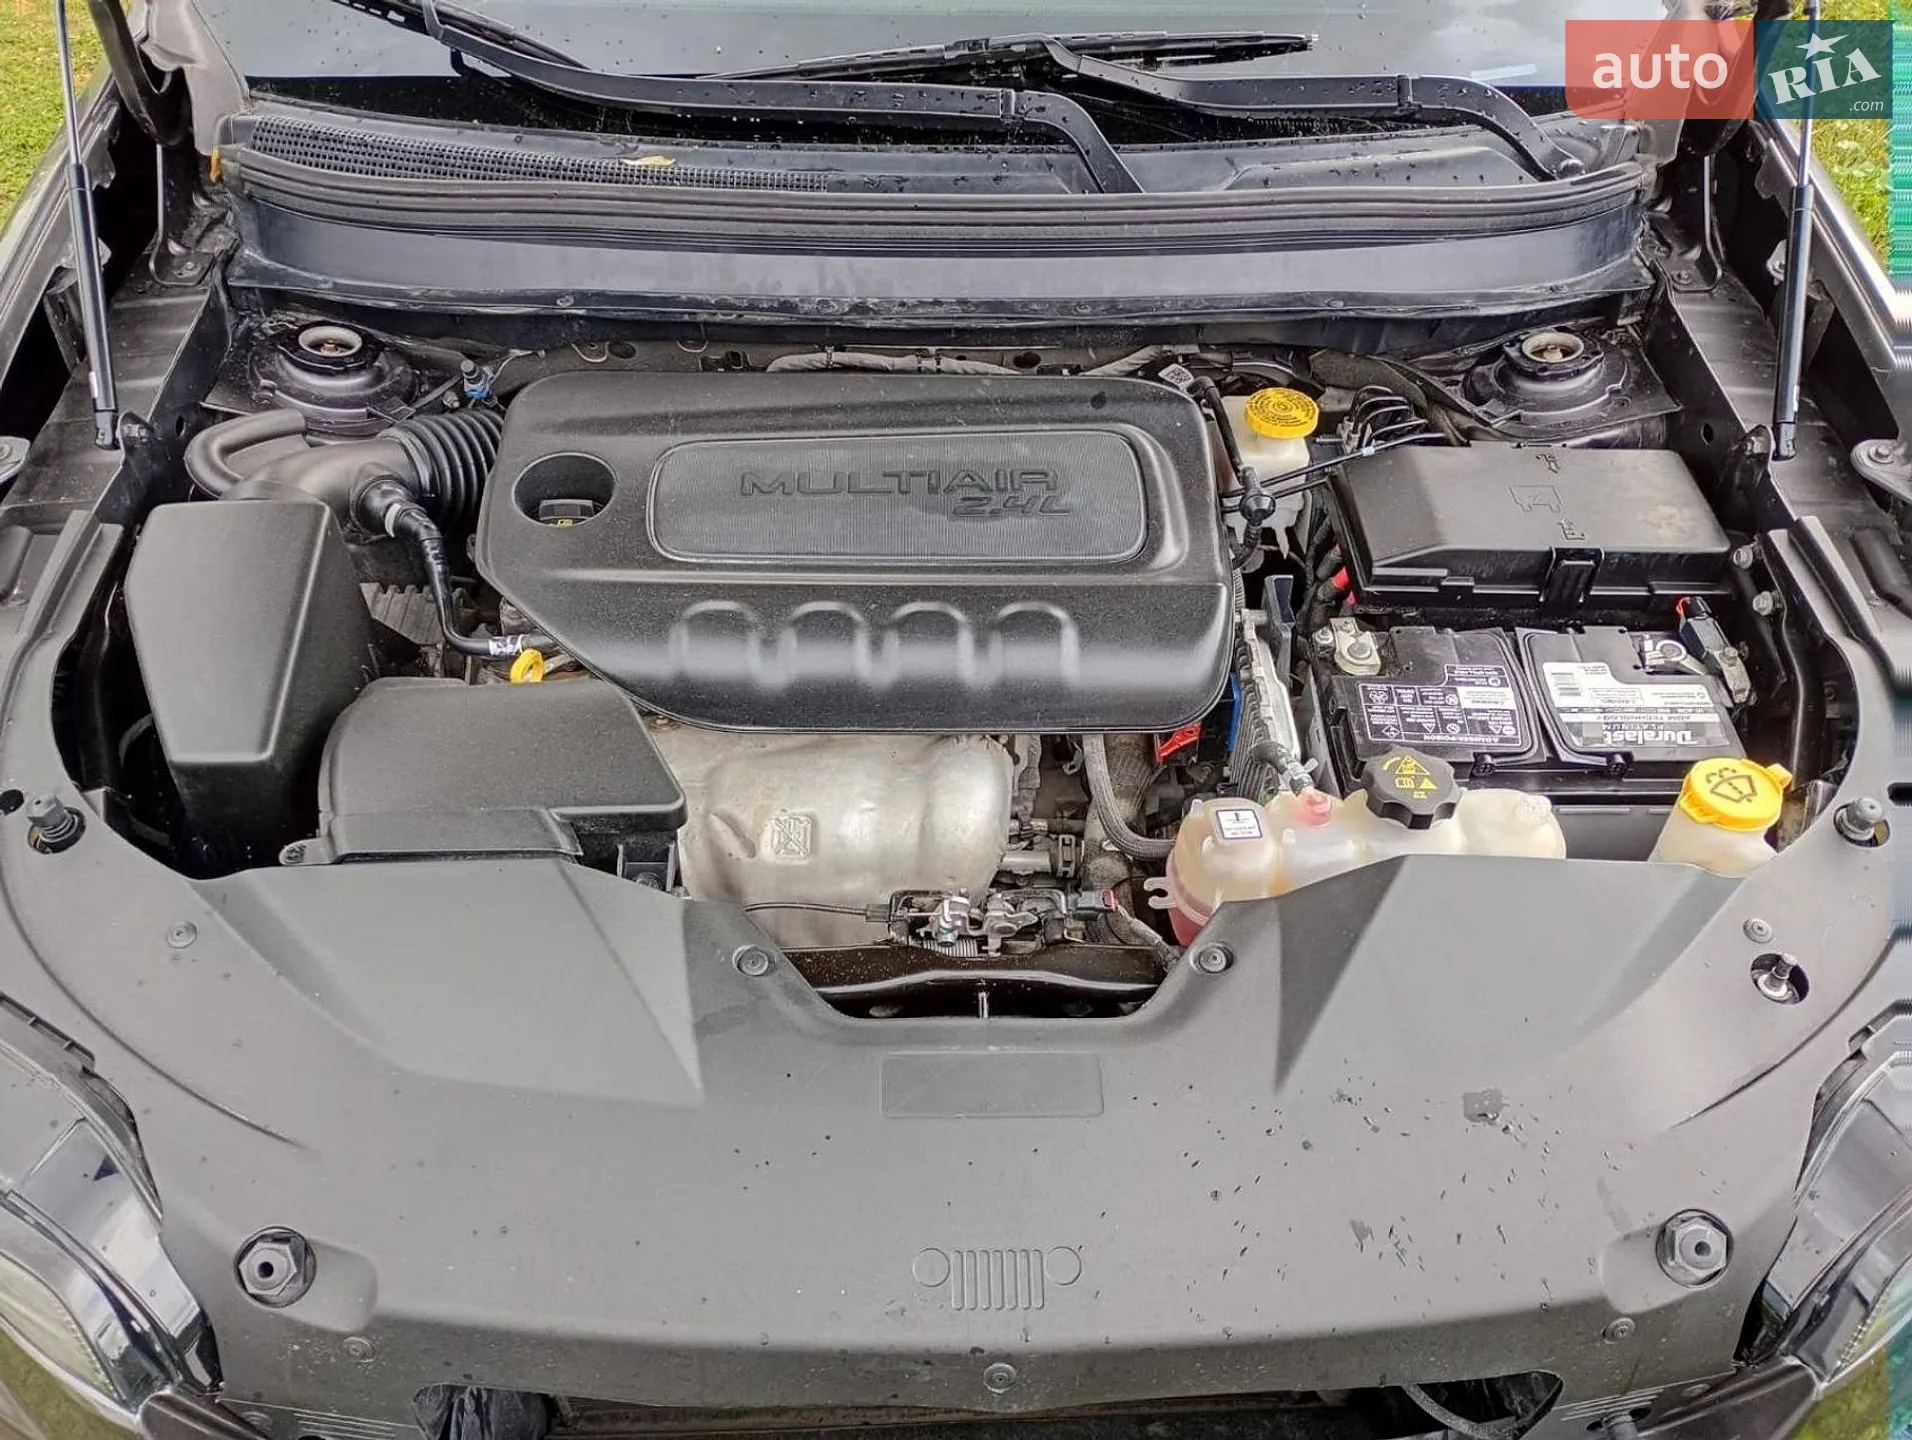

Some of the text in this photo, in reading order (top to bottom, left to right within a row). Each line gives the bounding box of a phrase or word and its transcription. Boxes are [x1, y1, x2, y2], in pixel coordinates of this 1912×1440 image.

[740, 469, 1059, 496] MULTIAIR
[951, 494, 1070, 517] 2.4L
[1602, 723, 1664, 731] PLATINUM
[1602, 730, 1699, 745] Duralast
